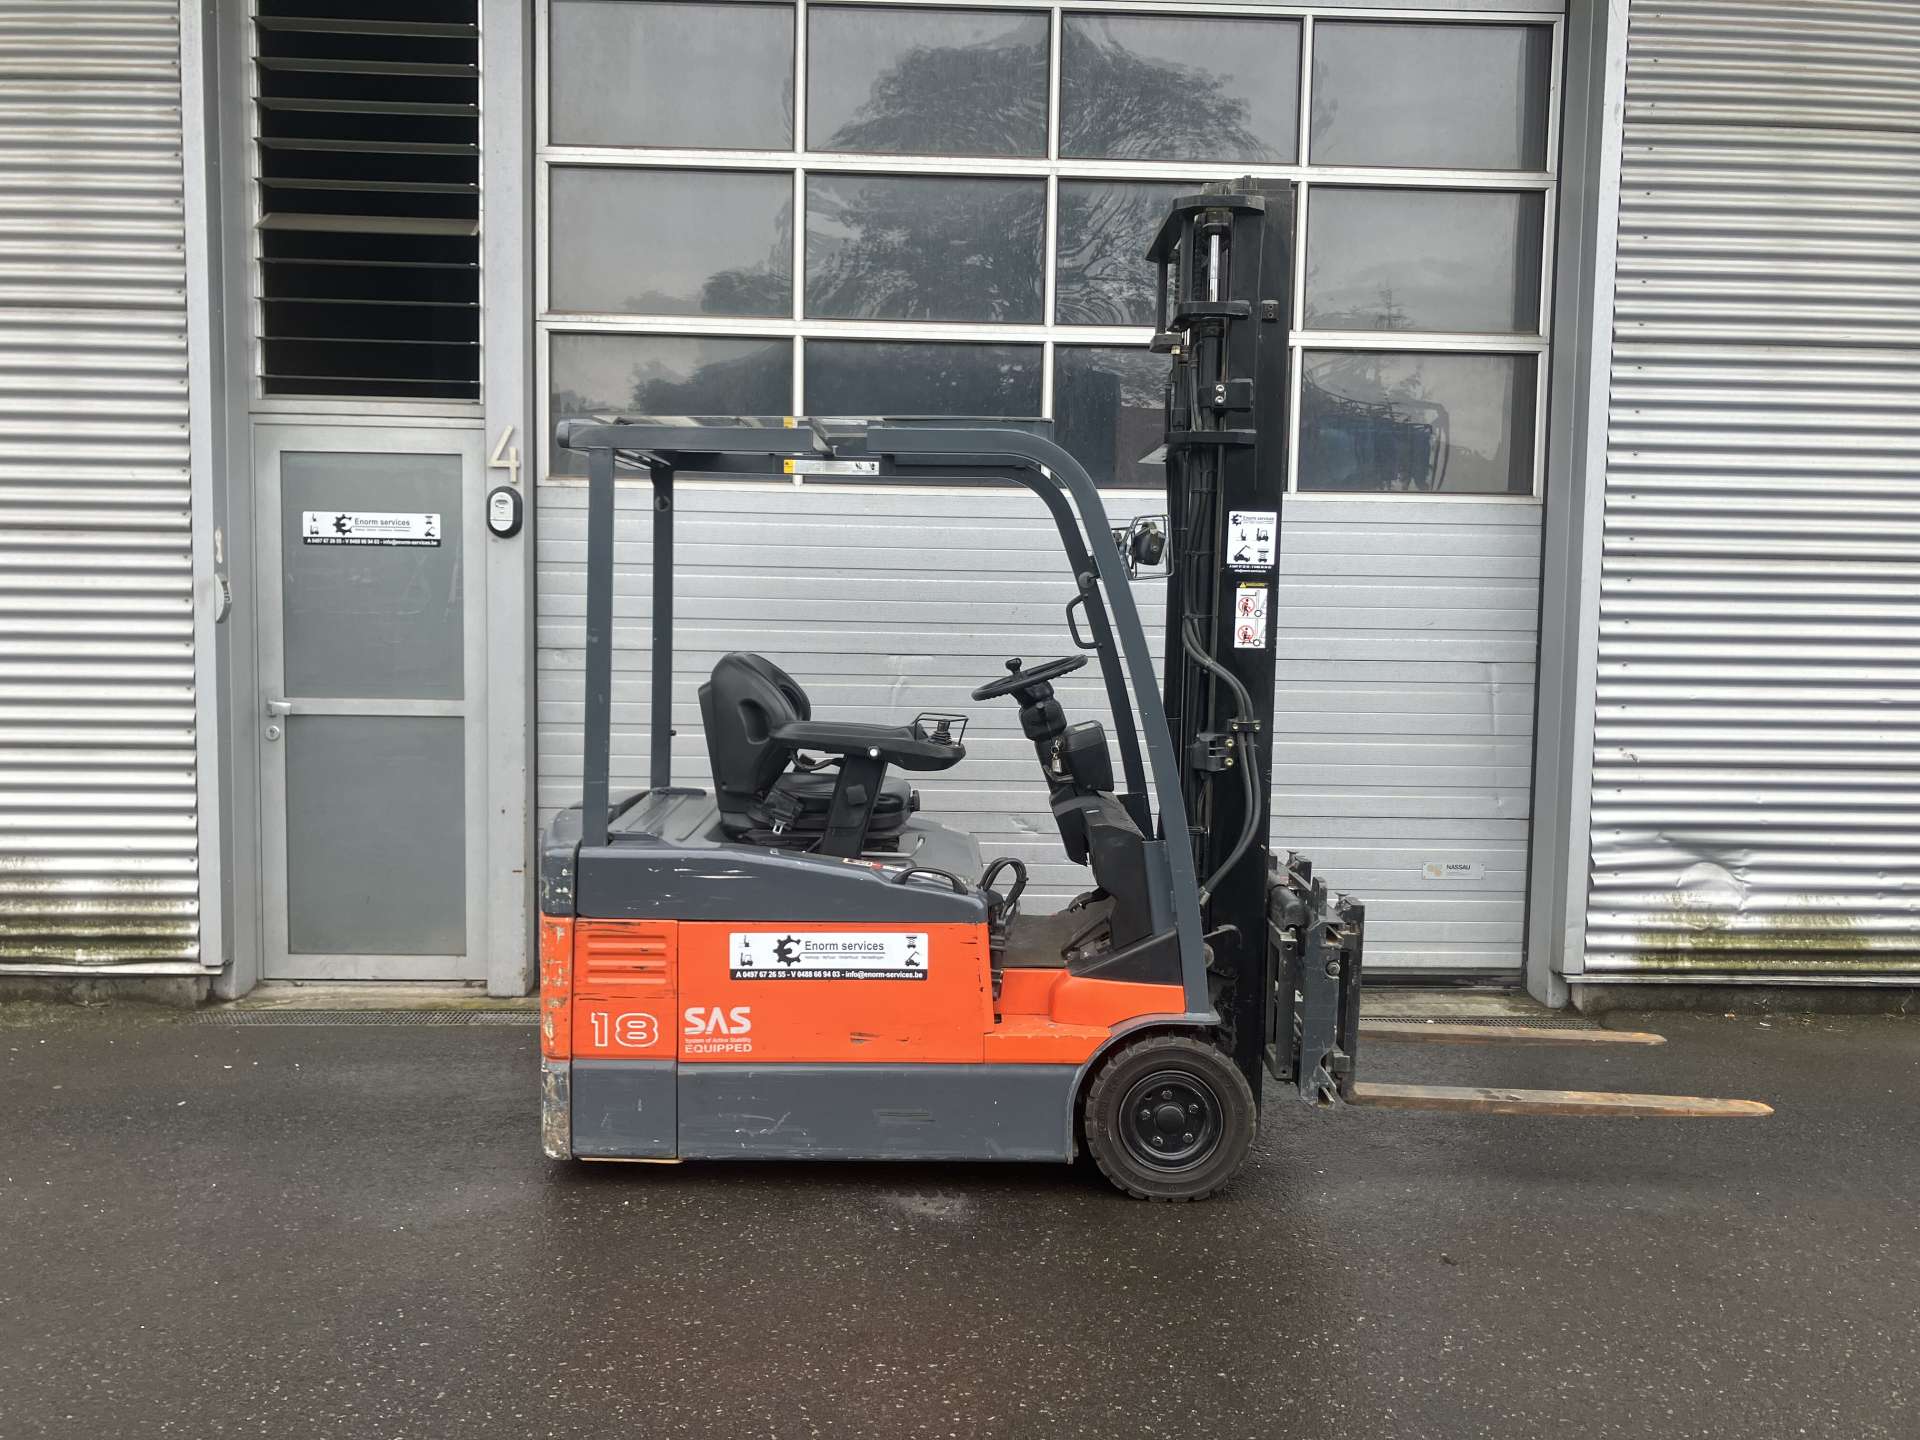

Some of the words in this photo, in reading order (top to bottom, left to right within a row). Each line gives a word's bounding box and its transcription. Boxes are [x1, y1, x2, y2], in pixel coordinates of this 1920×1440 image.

[487, 425, 520, 483] 4
[354, 518, 378, 526] Enorm
[380, 519, 410, 527] services
[804, 940, 839, 951] Enorm
[841, 940, 884, 951] services
[735, 970, 742, 978] A
[777, 970, 786, 978] 55
[791, 970, 797, 978] V
[823, 970, 832, 978] 94
[845, 970, 923, 979] info@enorm-services.be
[684, 1006, 752, 1035] SAS
[590, 1012, 659, 1048] 18
[684, 1043, 753, 1054] EQUIPPED
